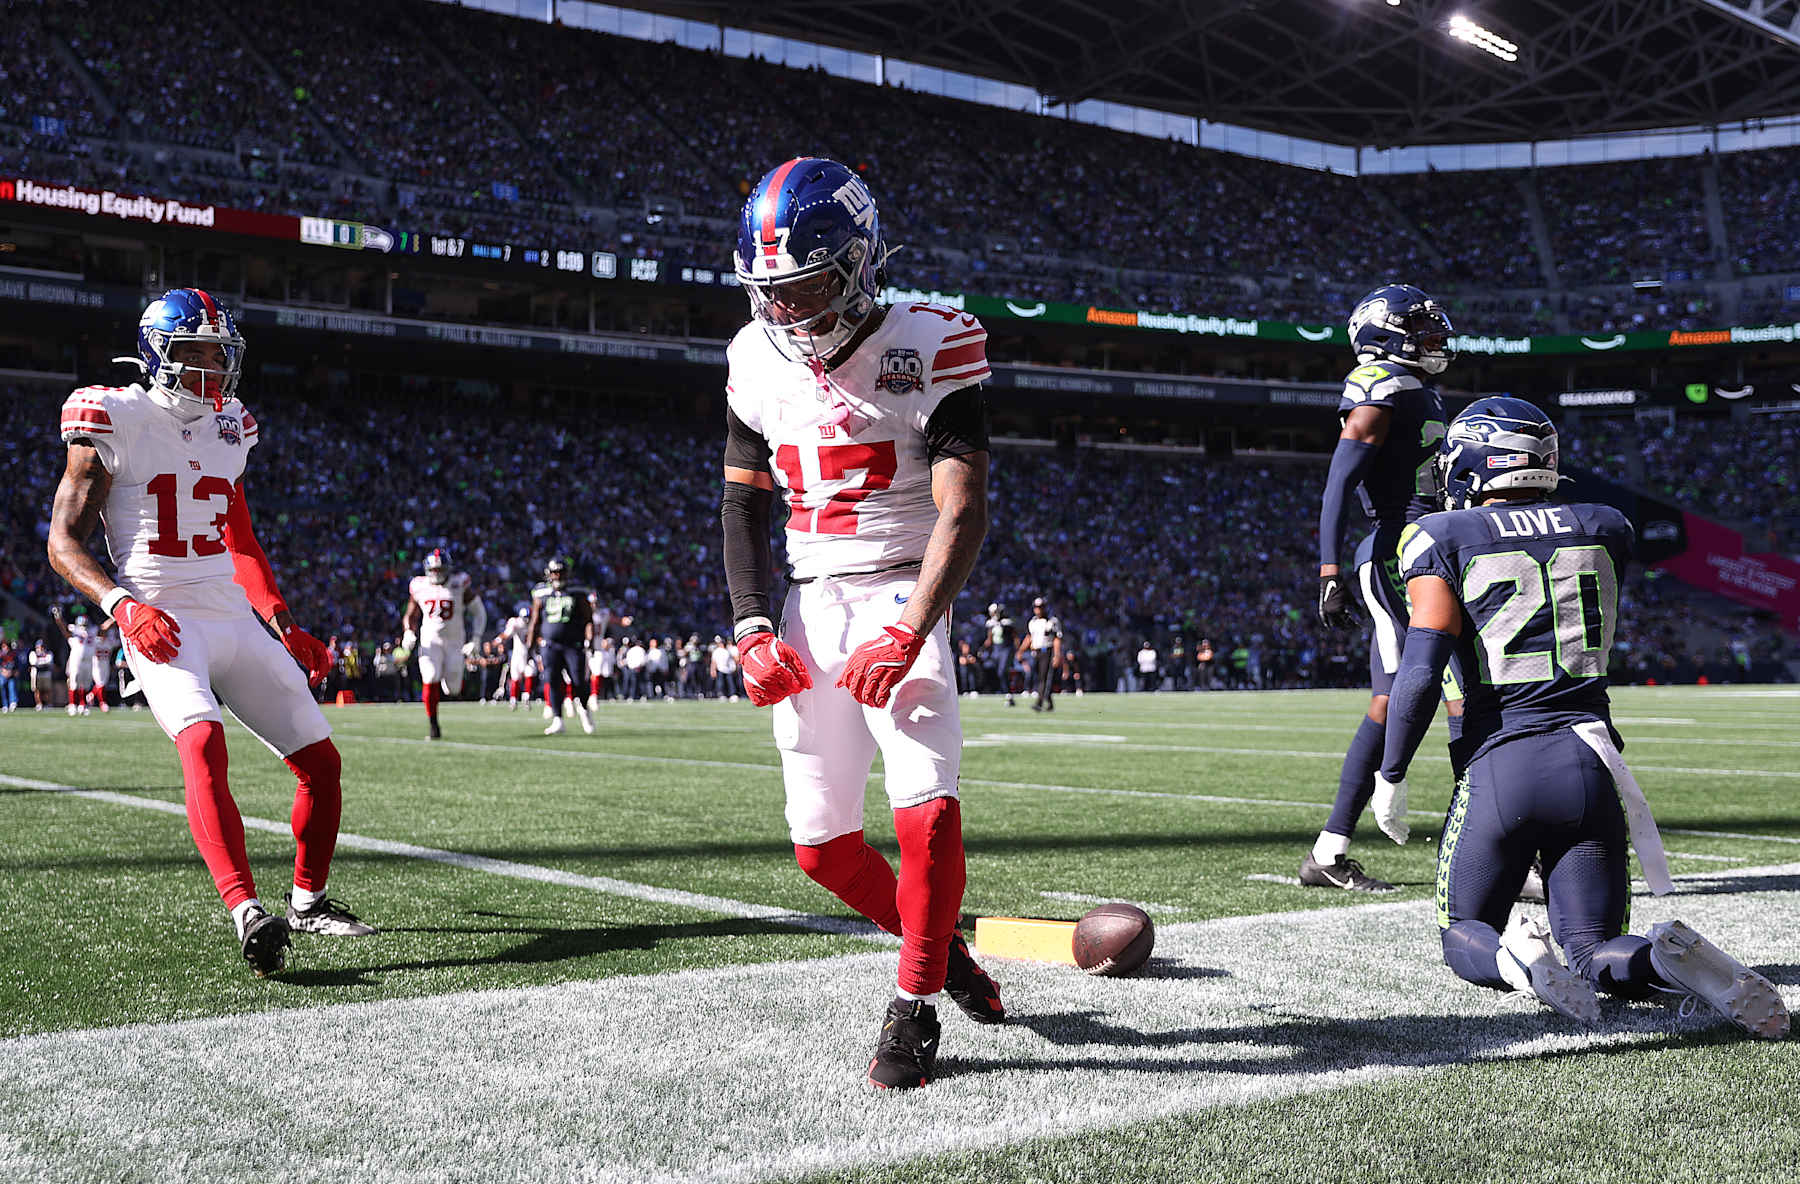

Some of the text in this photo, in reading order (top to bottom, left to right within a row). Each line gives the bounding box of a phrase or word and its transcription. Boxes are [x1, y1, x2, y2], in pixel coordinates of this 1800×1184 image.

[16, 179, 100, 215] Housing
[101, 190, 165, 223] Equity
[166, 200, 214, 227] Fund
[752, 227, 791, 255] 17
[1086, 306, 1258, 336] Amazon Housing Equity Fund
[1669, 330, 1731, 346] Amazon
[1730, 324, 1793, 342] Housing
[1456, 335, 1495, 355] Equity
[1495, 336, 1531, 353] Fund
[882, 356, 921, 376] 100
[776, 440, 898, 535] 17
[147, 474, 236, 557] 13
[1489, 507, 1572, 537] LOVE
[1463, 545, 1618, 685] 20
